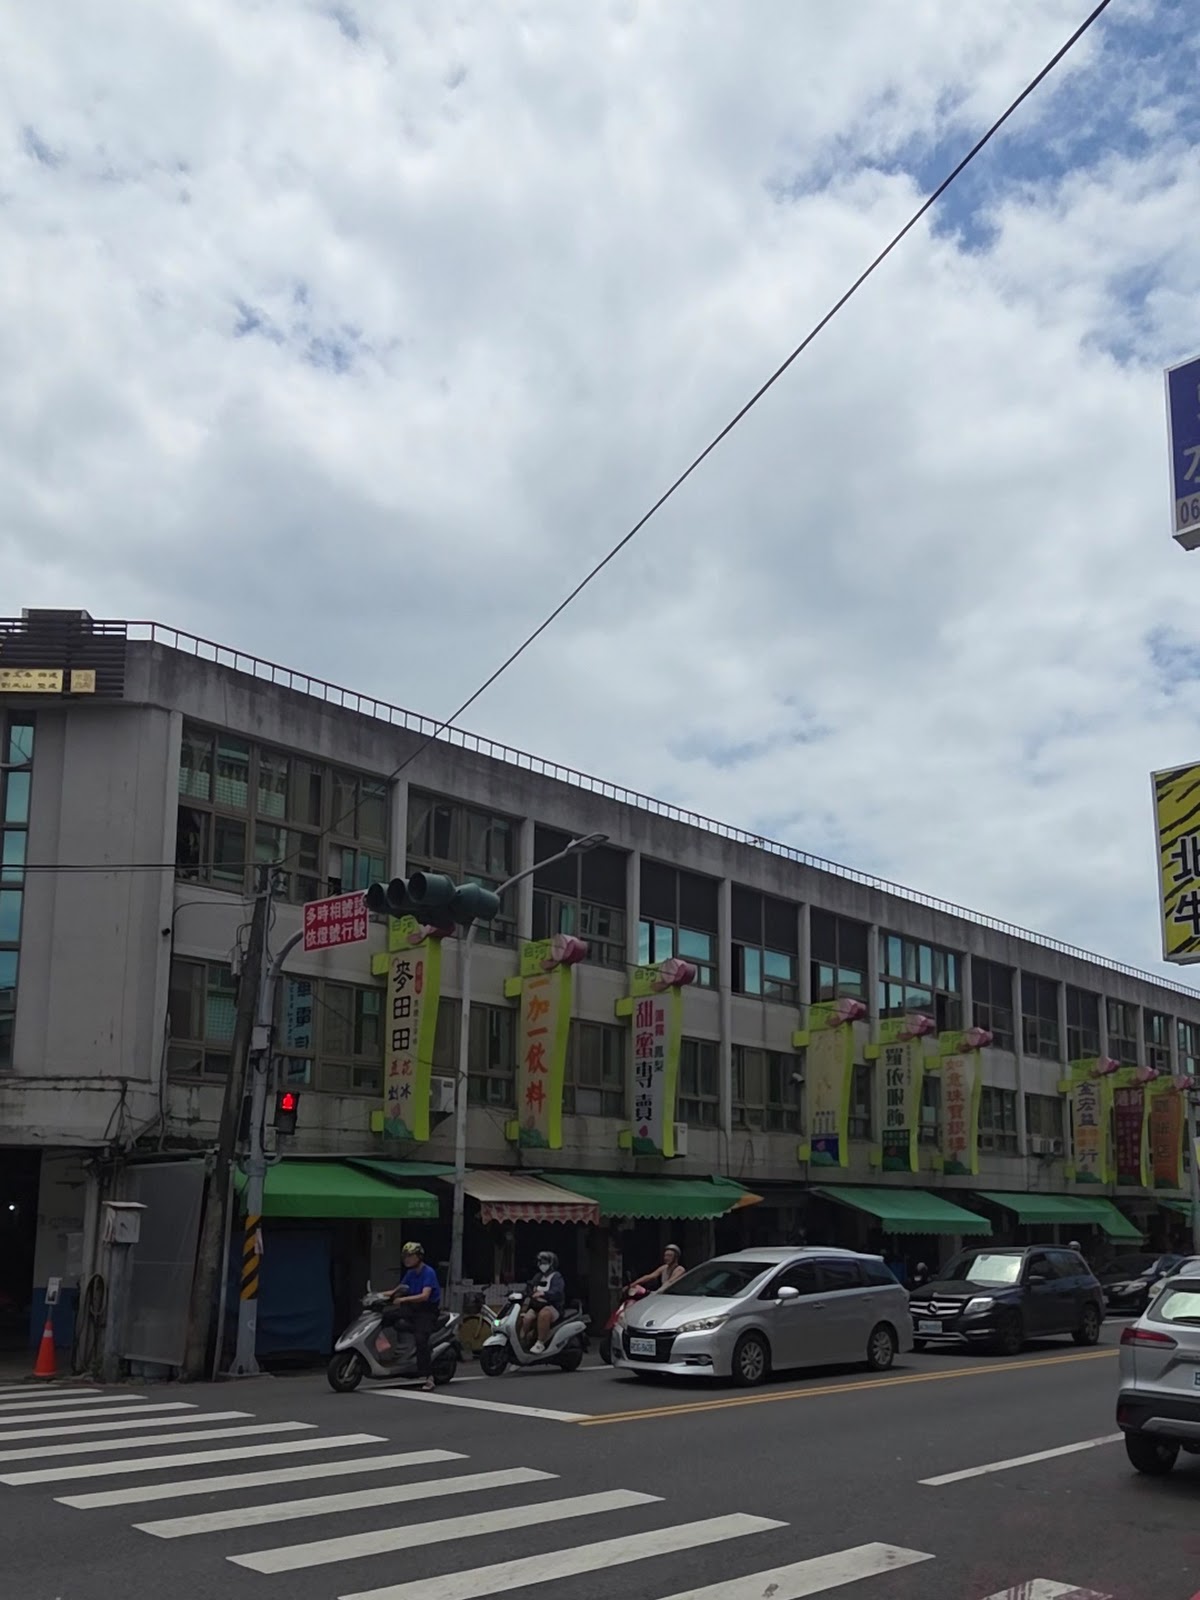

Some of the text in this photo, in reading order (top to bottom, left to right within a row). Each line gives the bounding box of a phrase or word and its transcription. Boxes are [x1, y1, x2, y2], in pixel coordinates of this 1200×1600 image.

[305, 918, 366, 948] 依燈號行駛
[306, 896, 366, 926] 多時相號誌
[524, 978, 551, 1115] 一加一飲料
[635, 1000, 654, 1122] 甜蜜專賣
